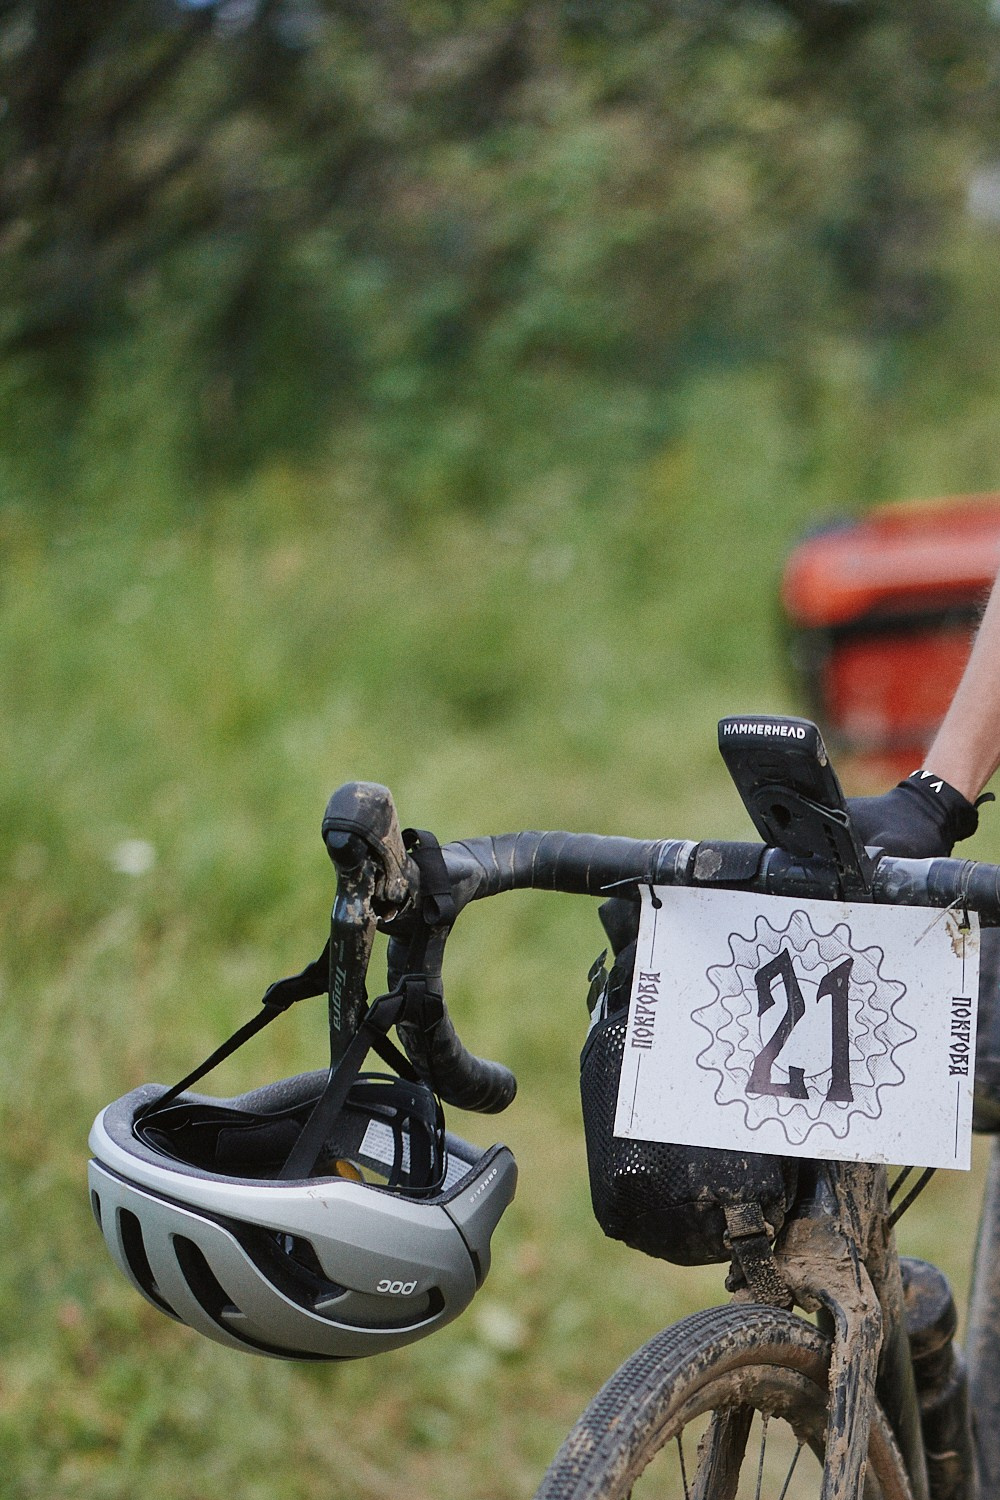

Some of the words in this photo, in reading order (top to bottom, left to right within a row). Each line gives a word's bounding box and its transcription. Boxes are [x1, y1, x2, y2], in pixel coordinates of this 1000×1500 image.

[723, 723, 806, 740] HAMMERHEAD
[332, 965, 347, 1032] Tiagra
[631, 971, 661, 1050] ПОКРОВА
[746, 947, 854, 1103] 21
[948, 996, 972, 1077] ПОКРОВА
